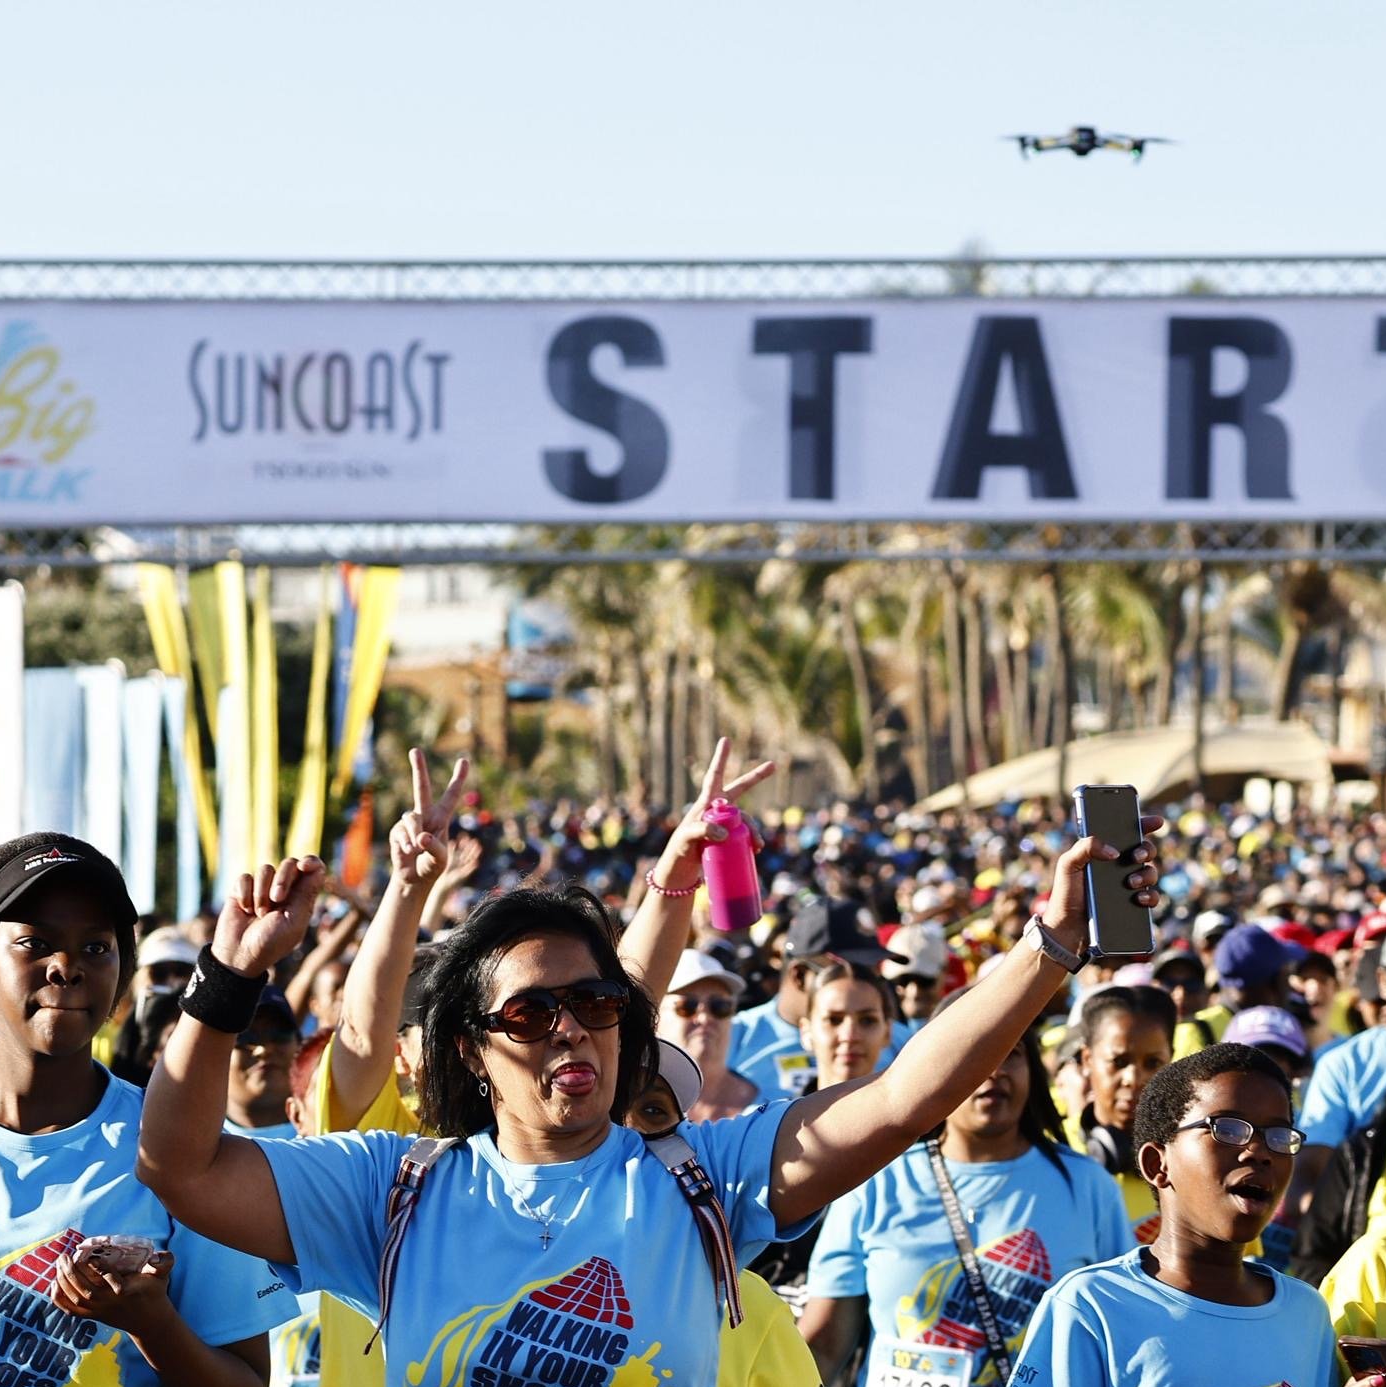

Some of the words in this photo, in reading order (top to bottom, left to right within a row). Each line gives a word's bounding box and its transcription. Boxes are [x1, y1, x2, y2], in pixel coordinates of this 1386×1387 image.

[189, 336, 453, 444] SUNCOAST
[480, 1330, 524, 1372] IN
[506, 1301, 629, 1365] WALKING
